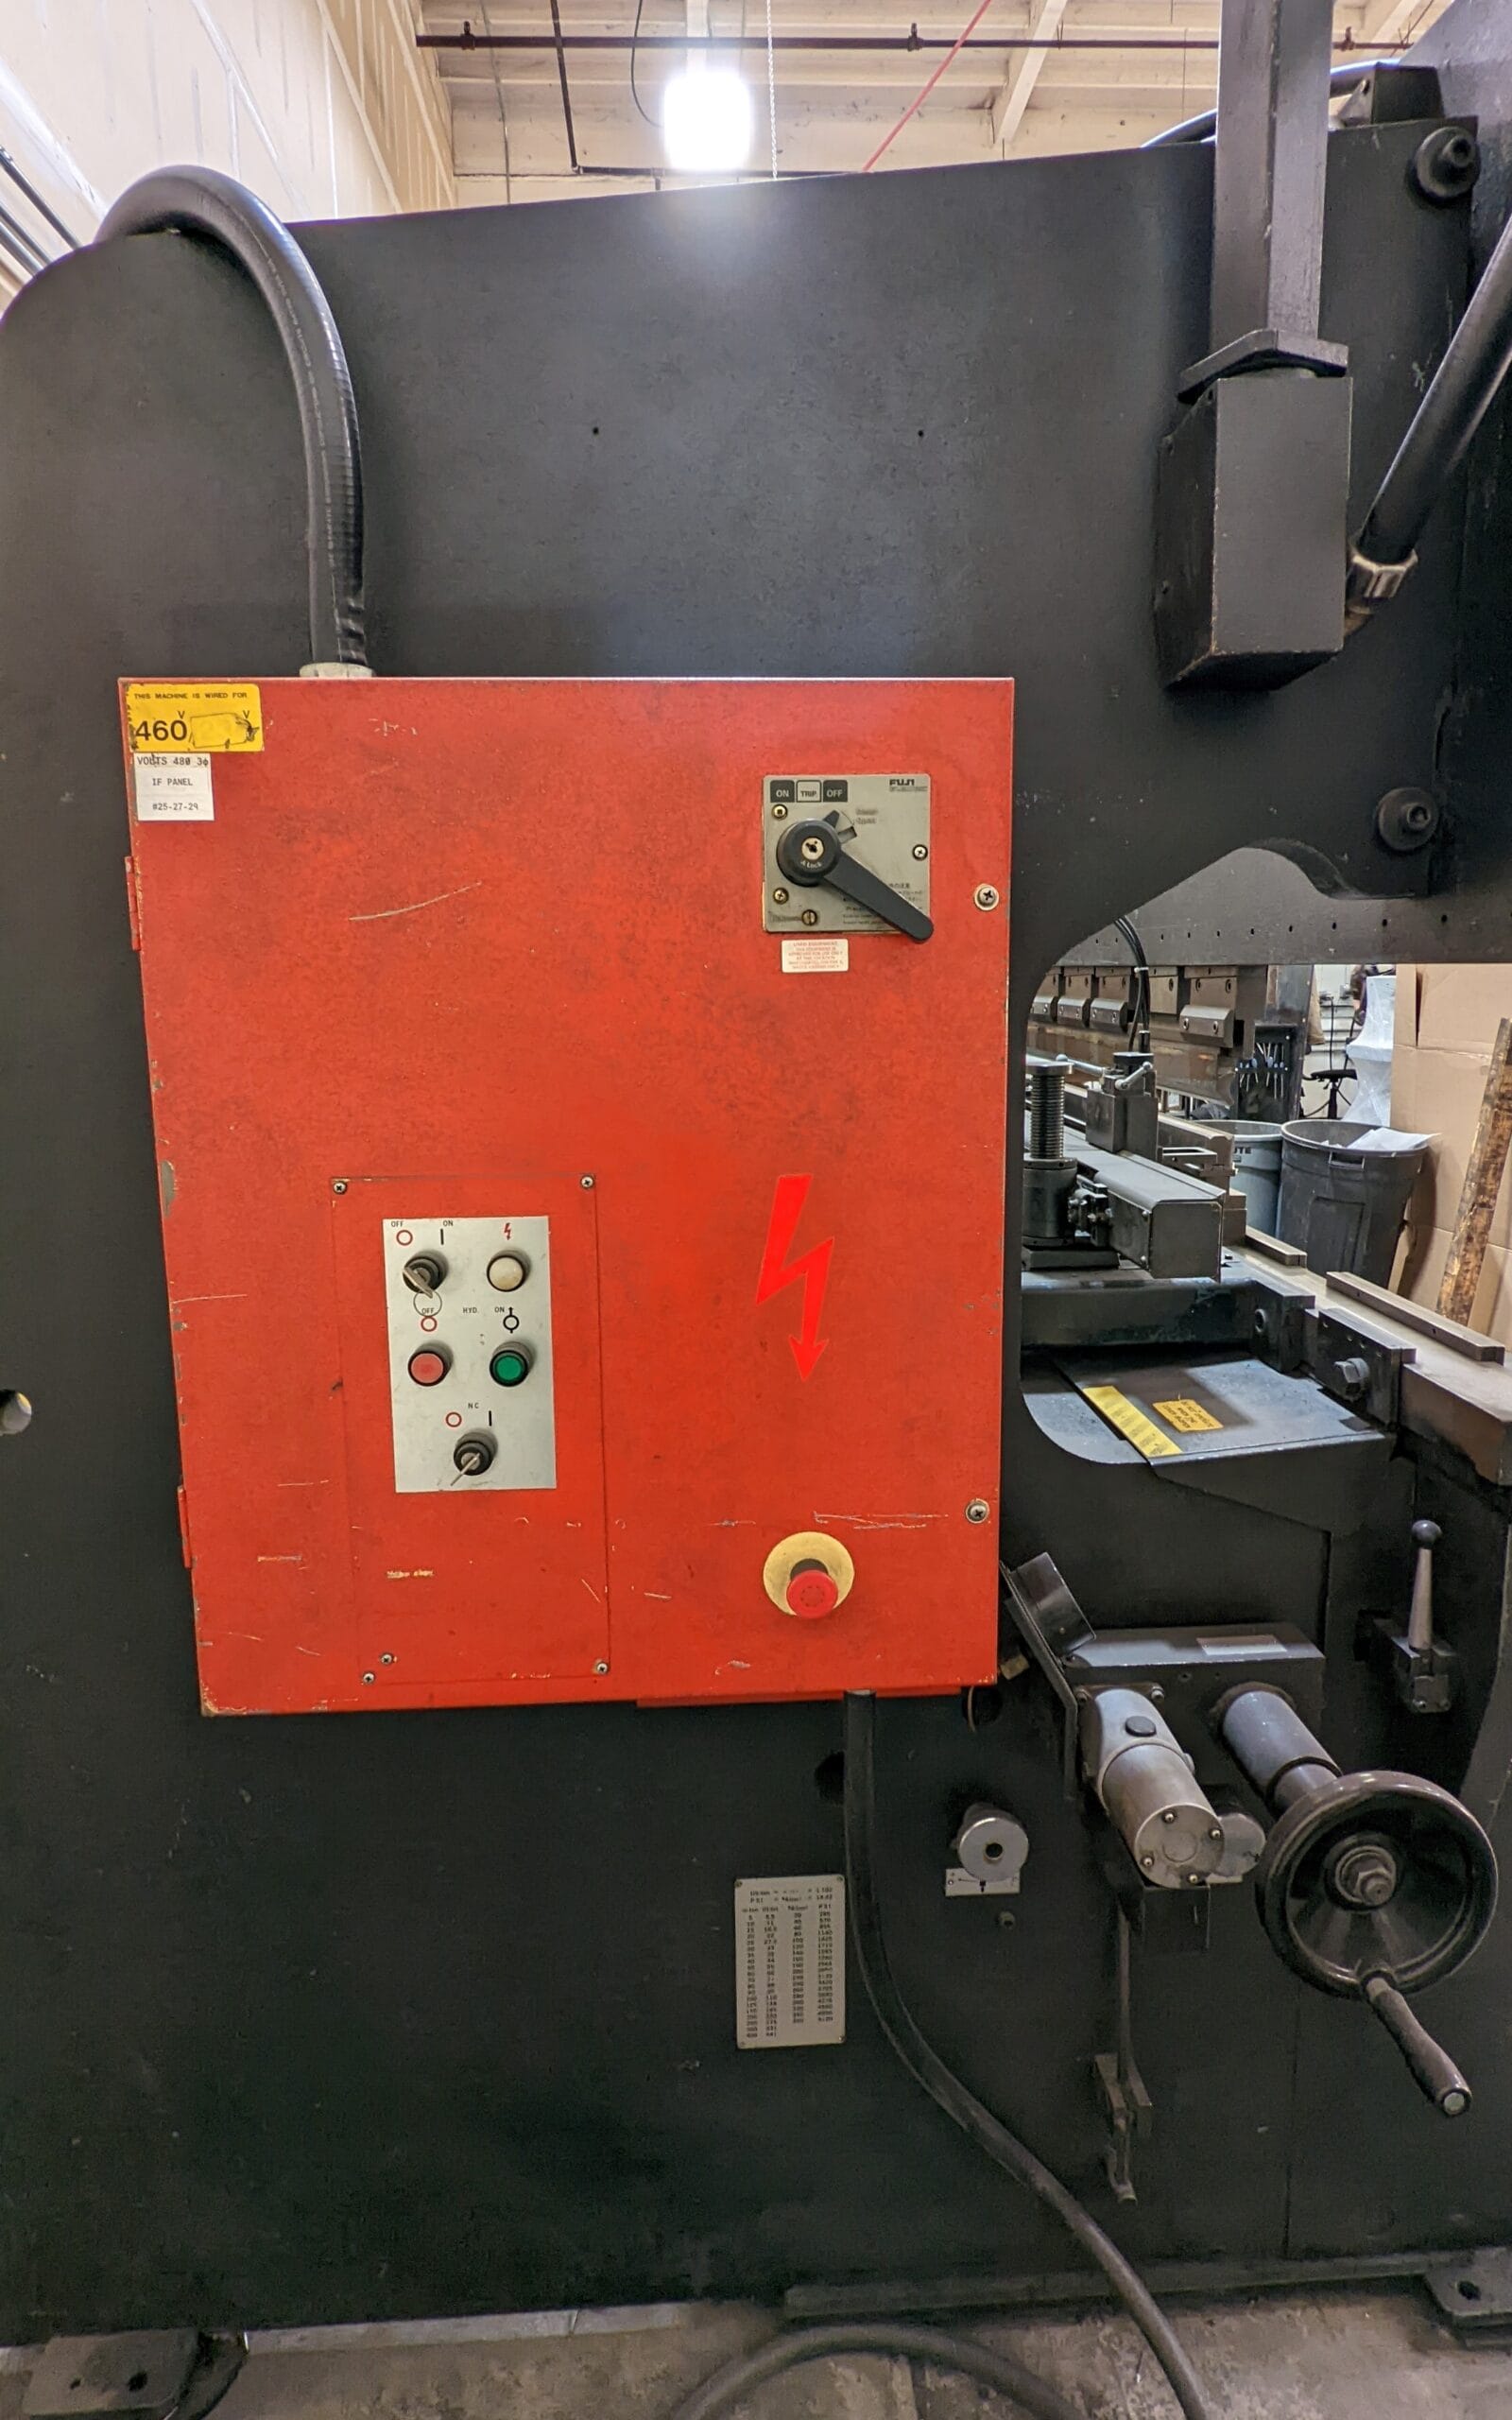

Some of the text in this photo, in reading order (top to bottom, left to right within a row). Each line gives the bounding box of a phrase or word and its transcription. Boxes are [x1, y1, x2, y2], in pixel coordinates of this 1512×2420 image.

[177, 710, 185, 719] V
[243, 710, 250, 719] V
[135, 719, 188, 741] 460
[172, 757, 191, 766] 480
[152, 778, 194, 786] IF PANEL
[775, 788, 790, 798] ON
[826, 788, 843, 798] OFF
